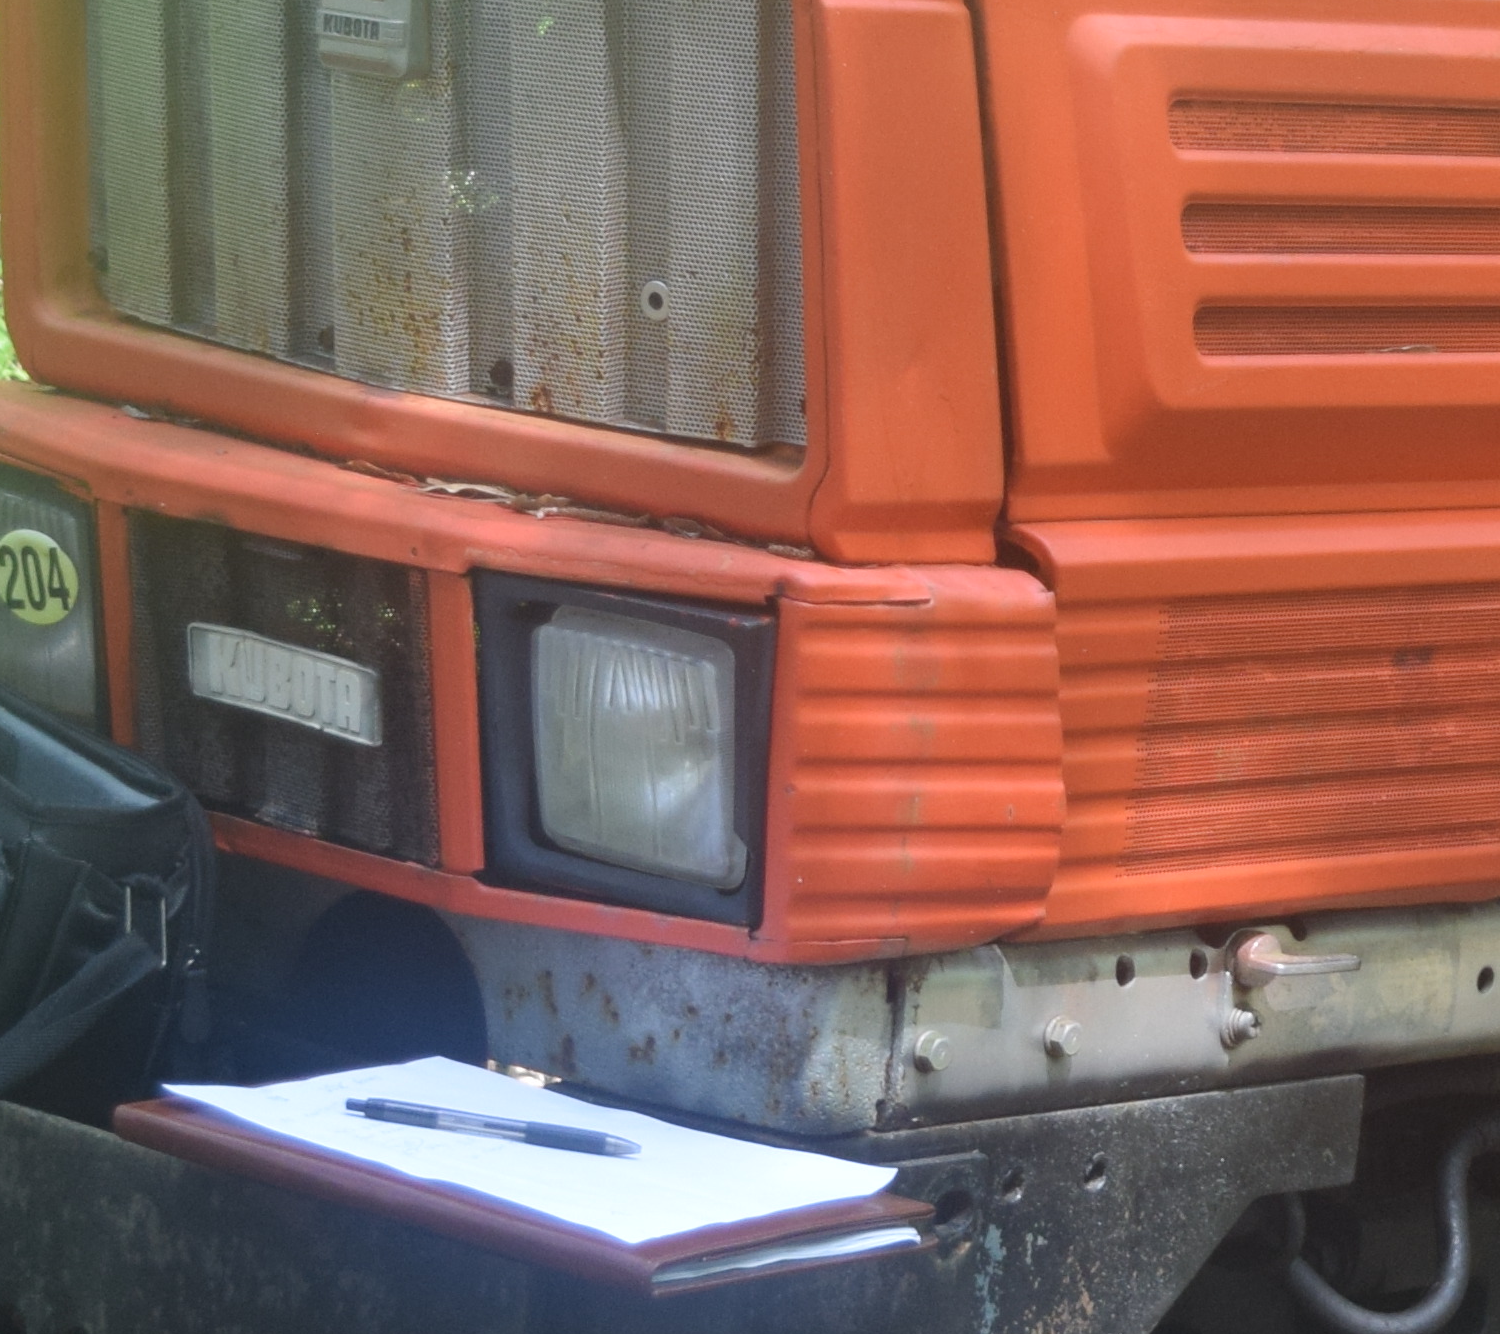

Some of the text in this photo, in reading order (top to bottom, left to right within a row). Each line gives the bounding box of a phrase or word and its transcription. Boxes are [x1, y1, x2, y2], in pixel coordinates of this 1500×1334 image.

[322, 13, 380, 41] KUBOTA
[0, 544, 71, 612] 204
[206, 631, 362, 734] KUBOTA
